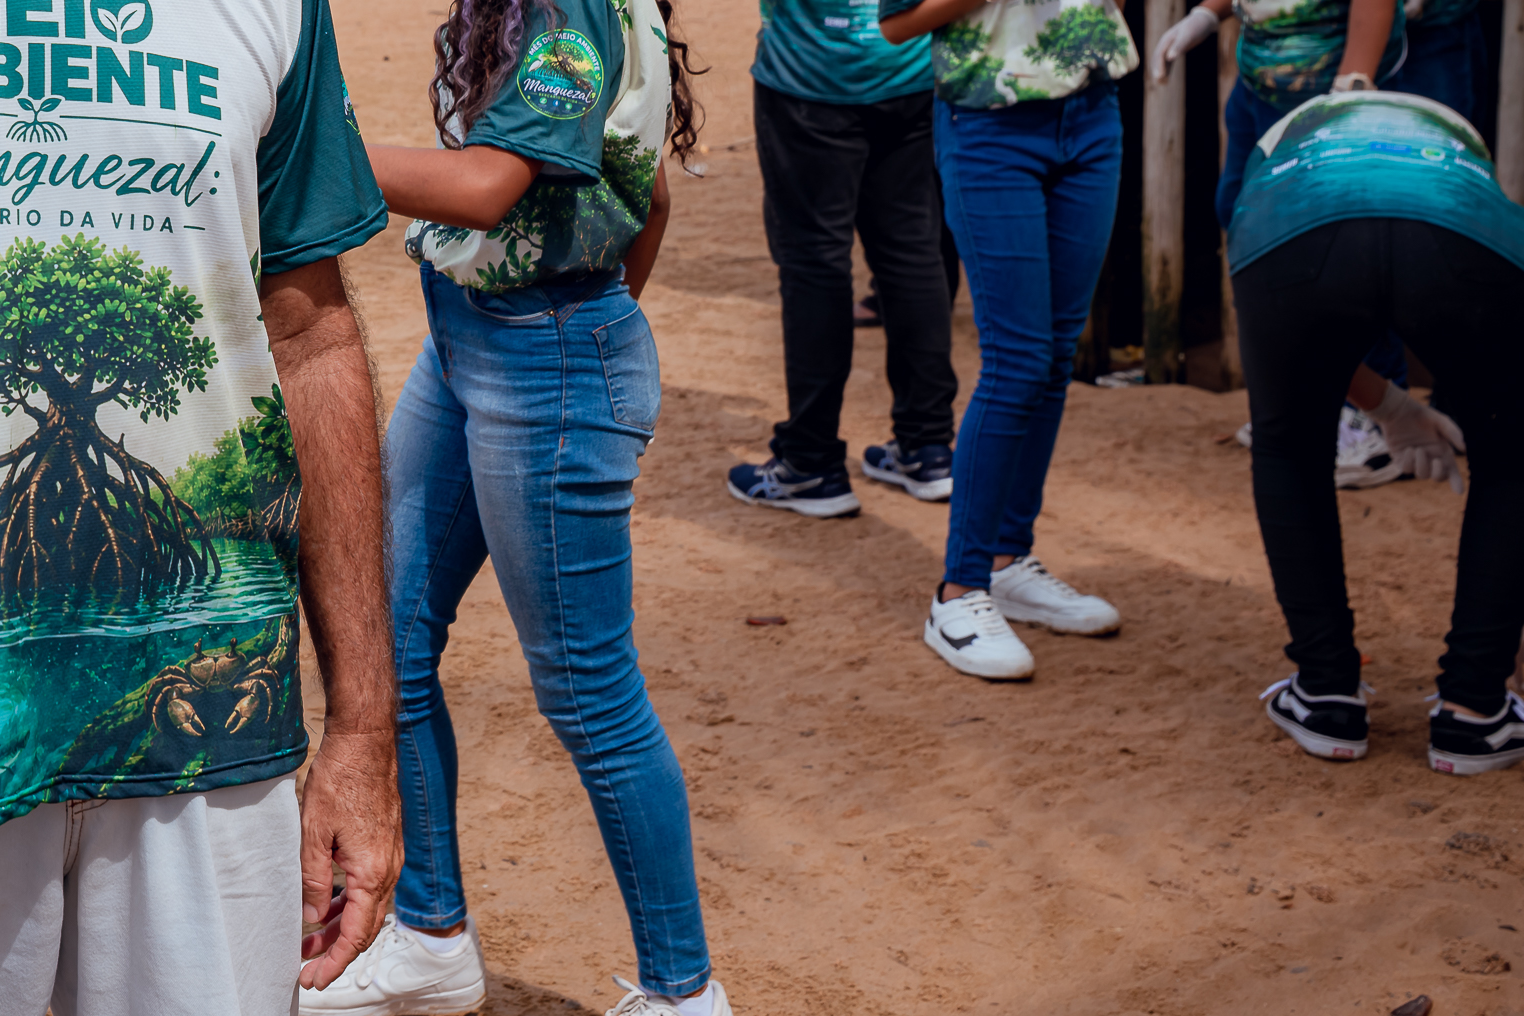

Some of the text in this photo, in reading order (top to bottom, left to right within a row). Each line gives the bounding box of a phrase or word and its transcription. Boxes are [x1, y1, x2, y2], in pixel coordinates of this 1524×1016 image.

[529, 40, 543, 56] MÊS
[556, 32, 576, 41] MEIO
[576, 37, 601, 72] AMBIENTE
[60, 210, 95, 229] DA
[111, 212, 174, 233] VIDA
